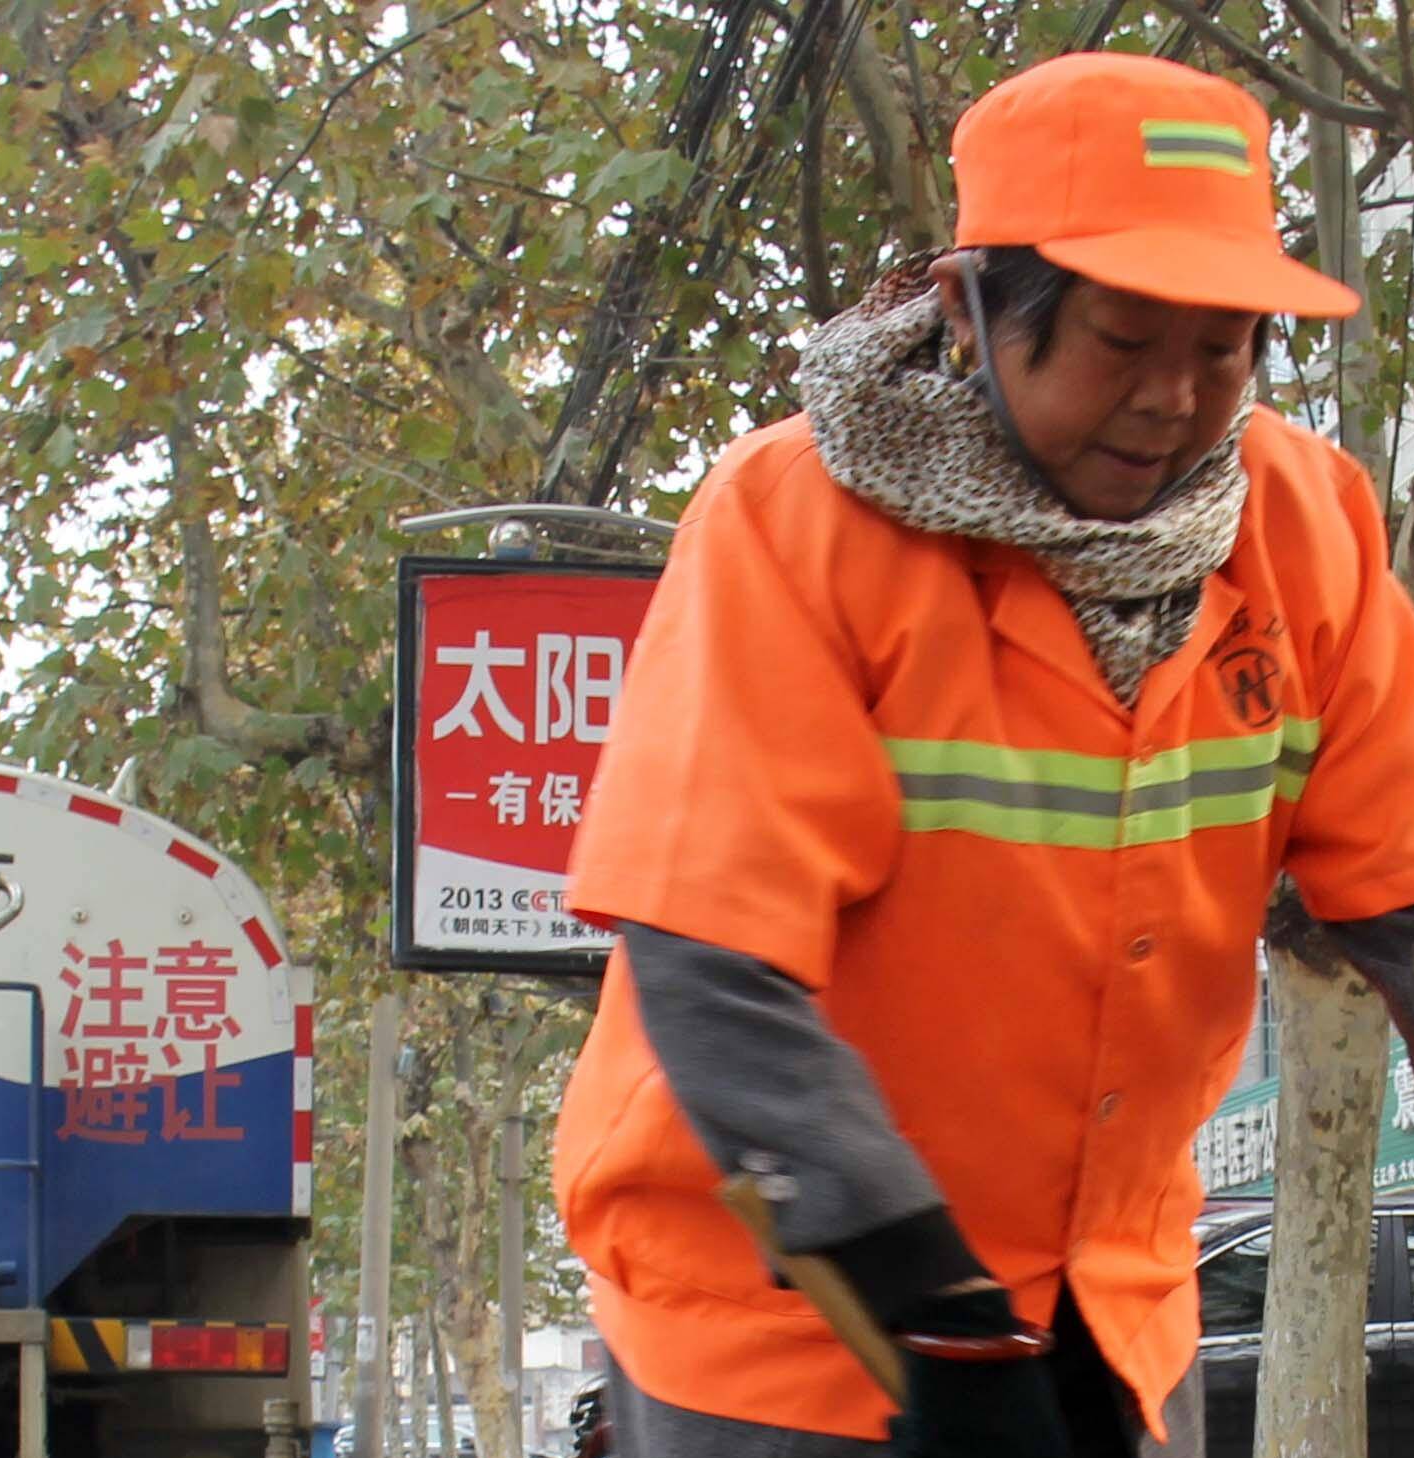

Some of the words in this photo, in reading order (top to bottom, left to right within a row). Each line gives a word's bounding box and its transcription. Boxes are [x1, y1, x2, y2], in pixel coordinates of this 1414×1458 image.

[432, 629, 625, 745] 太阳
[440, 887, 503, 911] 2013
[59, 939, 241, 1041] 注意
[57, 1043, 245, 1145] 避让
